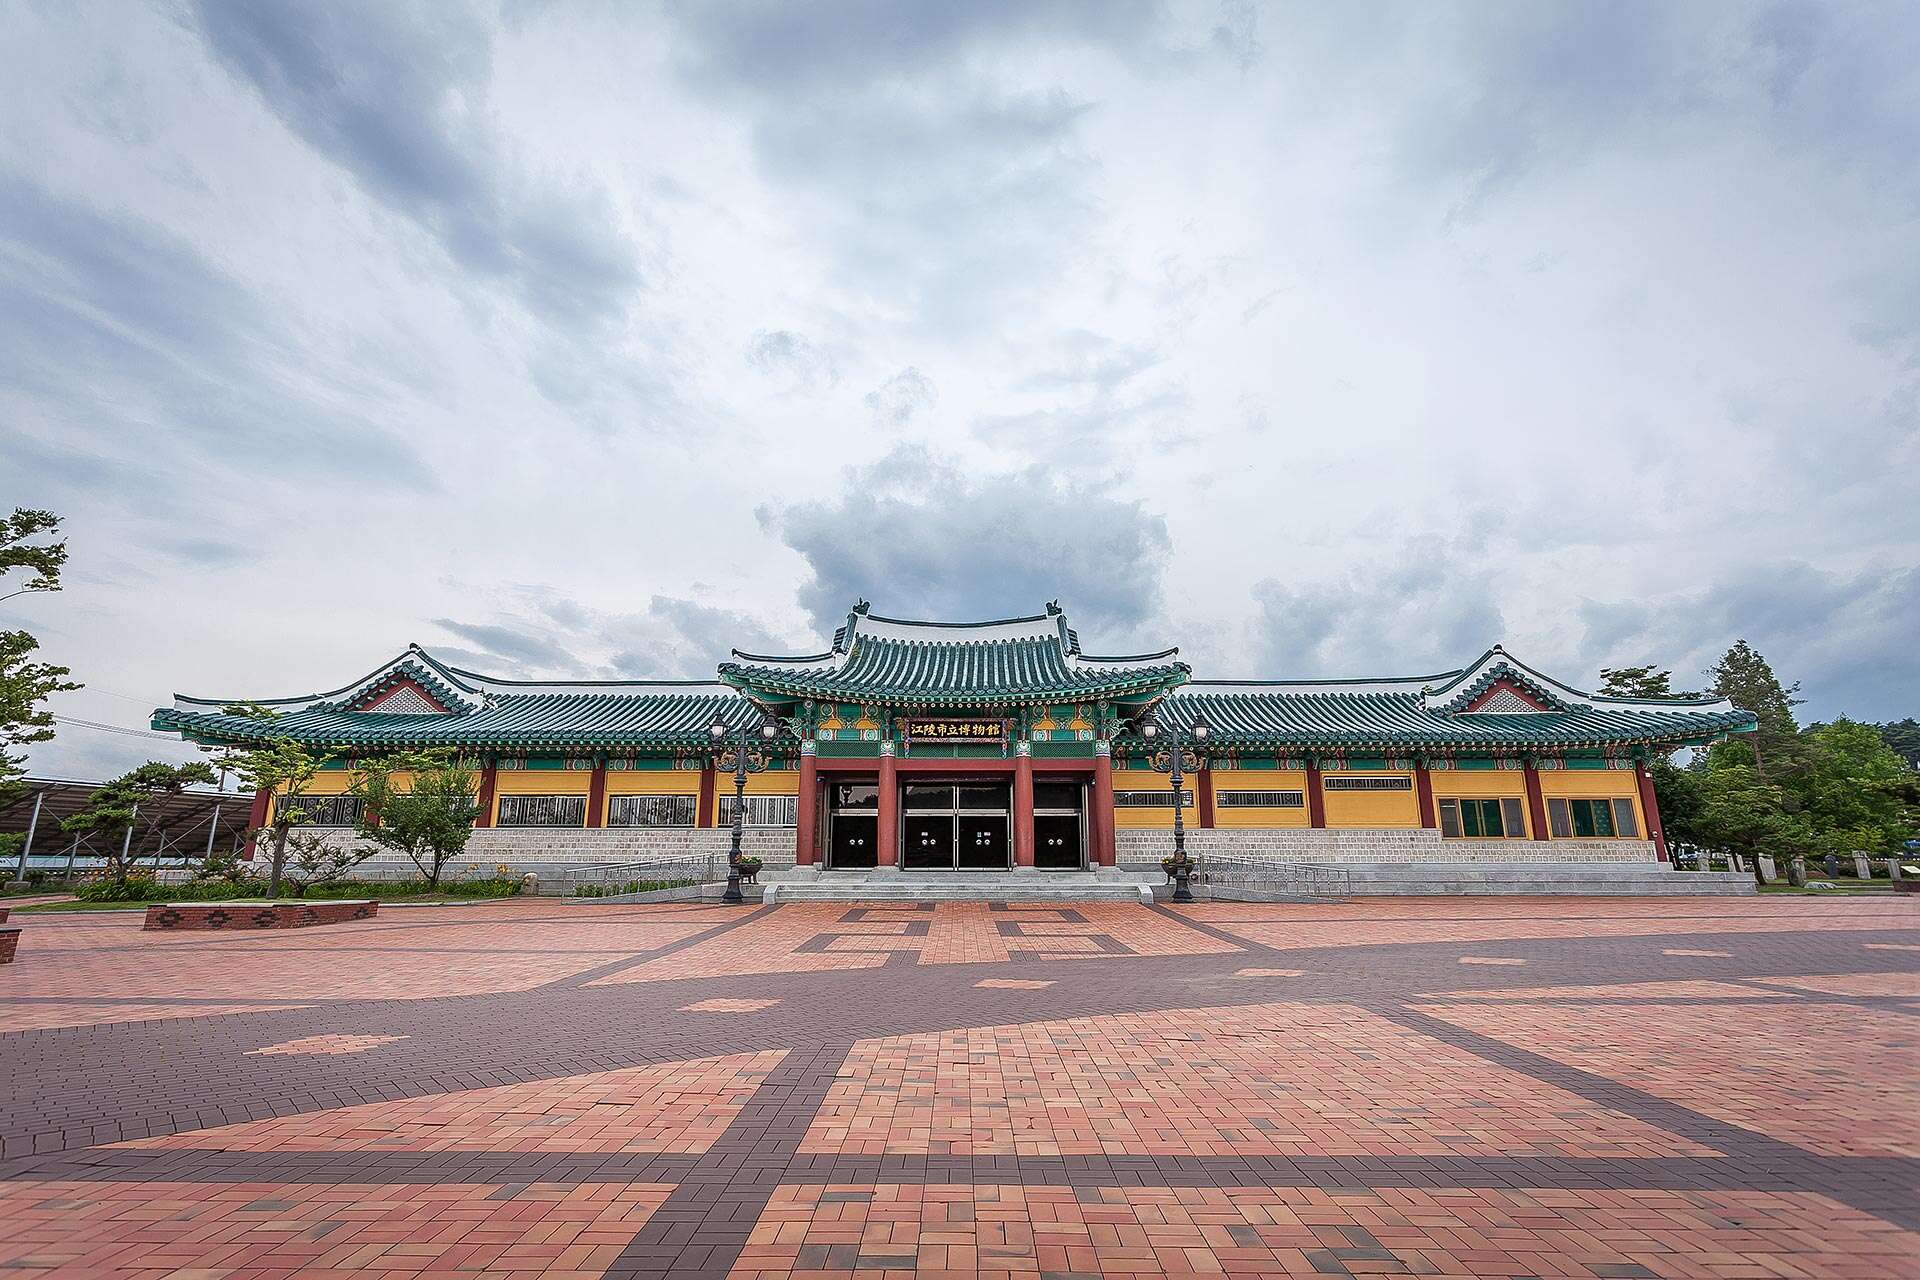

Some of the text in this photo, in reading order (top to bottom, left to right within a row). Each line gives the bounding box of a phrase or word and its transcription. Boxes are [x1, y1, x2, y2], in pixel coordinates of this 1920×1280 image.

[911, 722, 1001, 737] 江陵市立博物館
